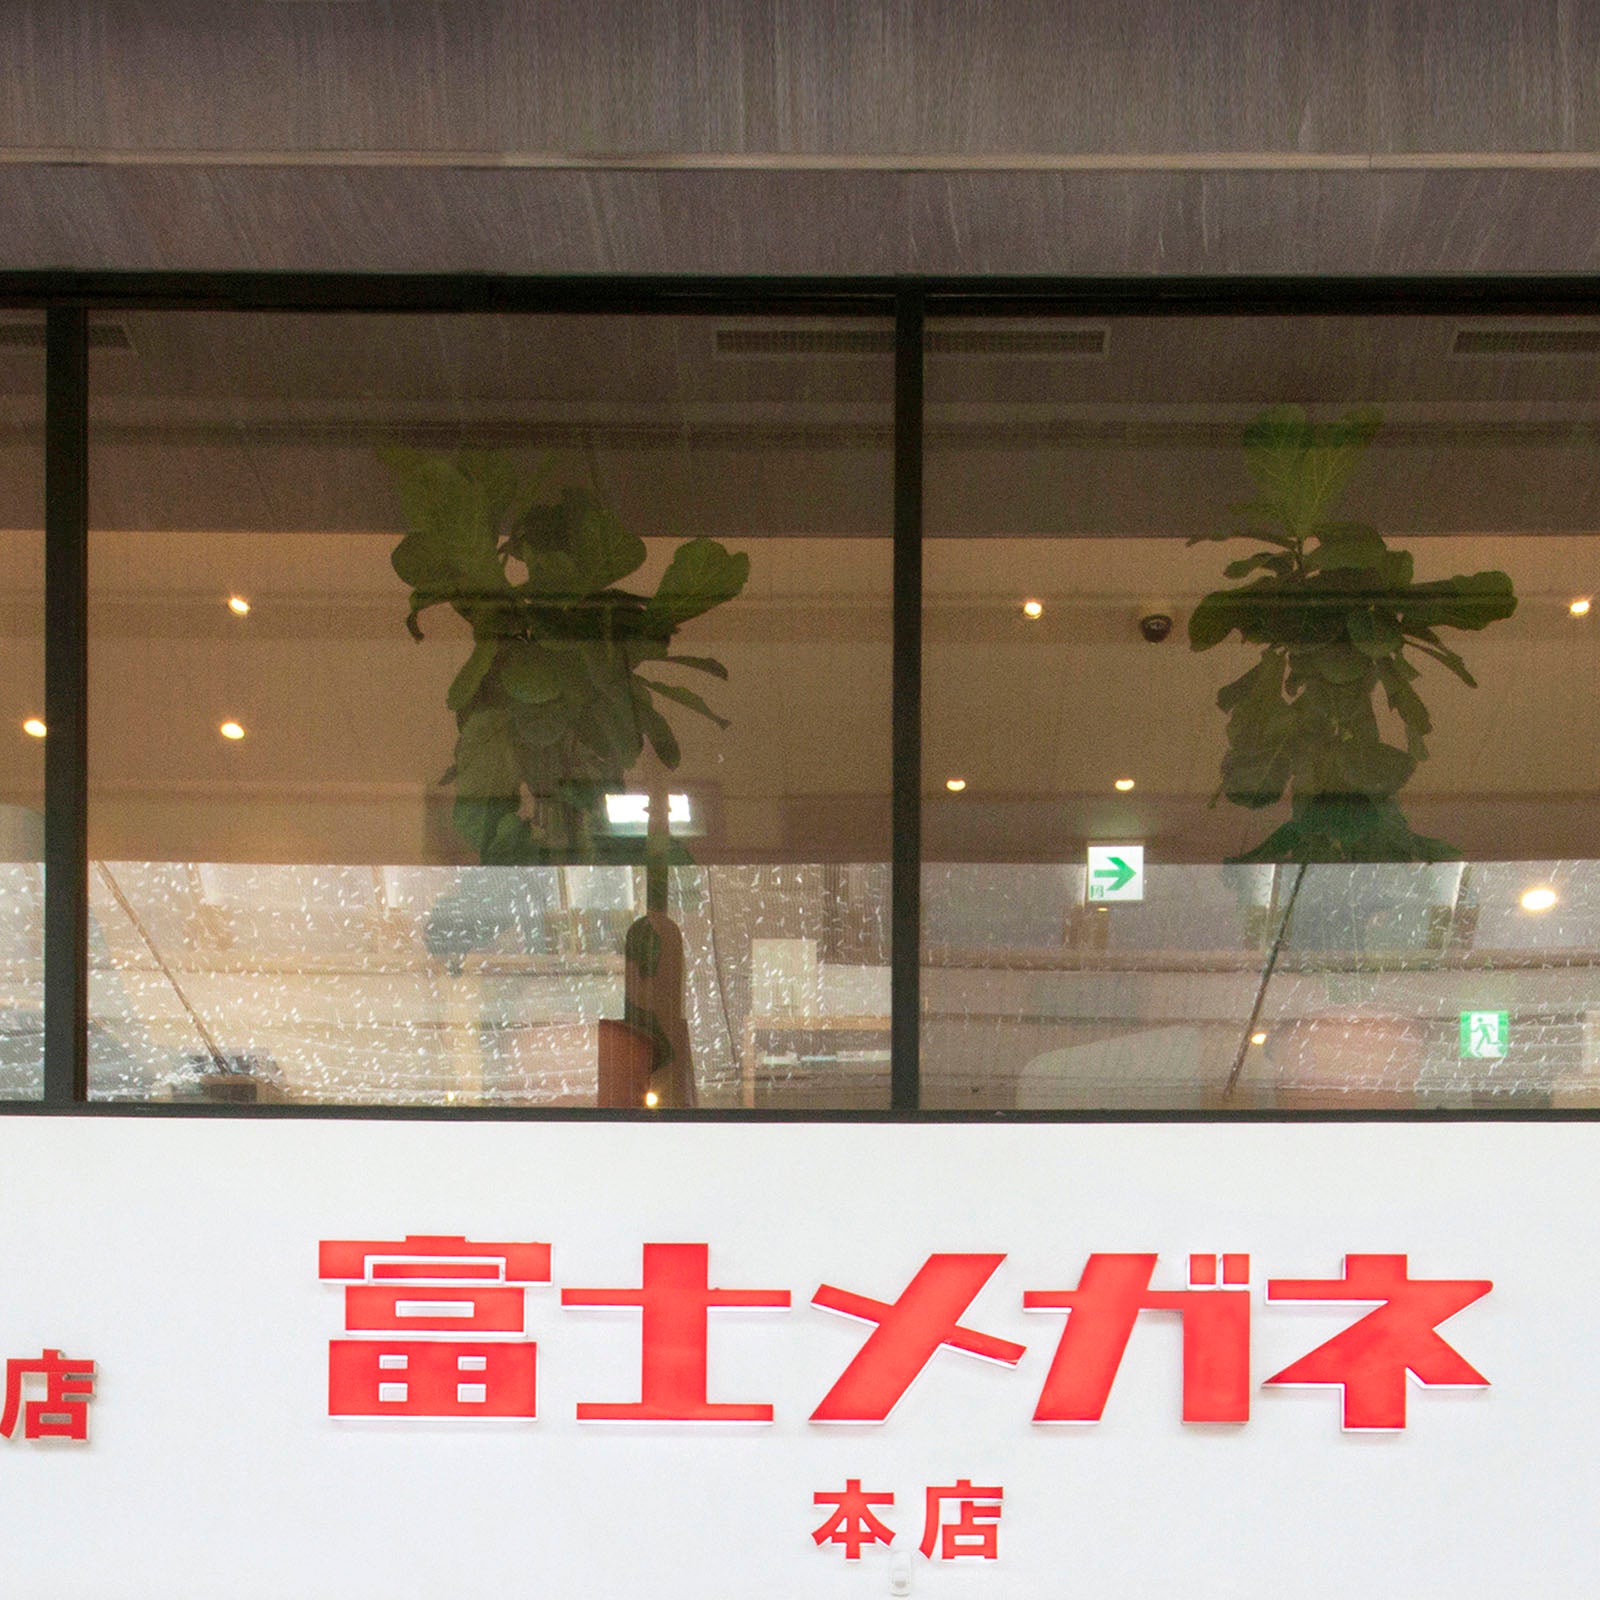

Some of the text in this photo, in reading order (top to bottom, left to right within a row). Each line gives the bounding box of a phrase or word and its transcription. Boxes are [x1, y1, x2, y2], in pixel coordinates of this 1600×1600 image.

[318, 1234, 1494, 1432] 富士メガネ
[812, 1480, 1003, 1561] 本店
